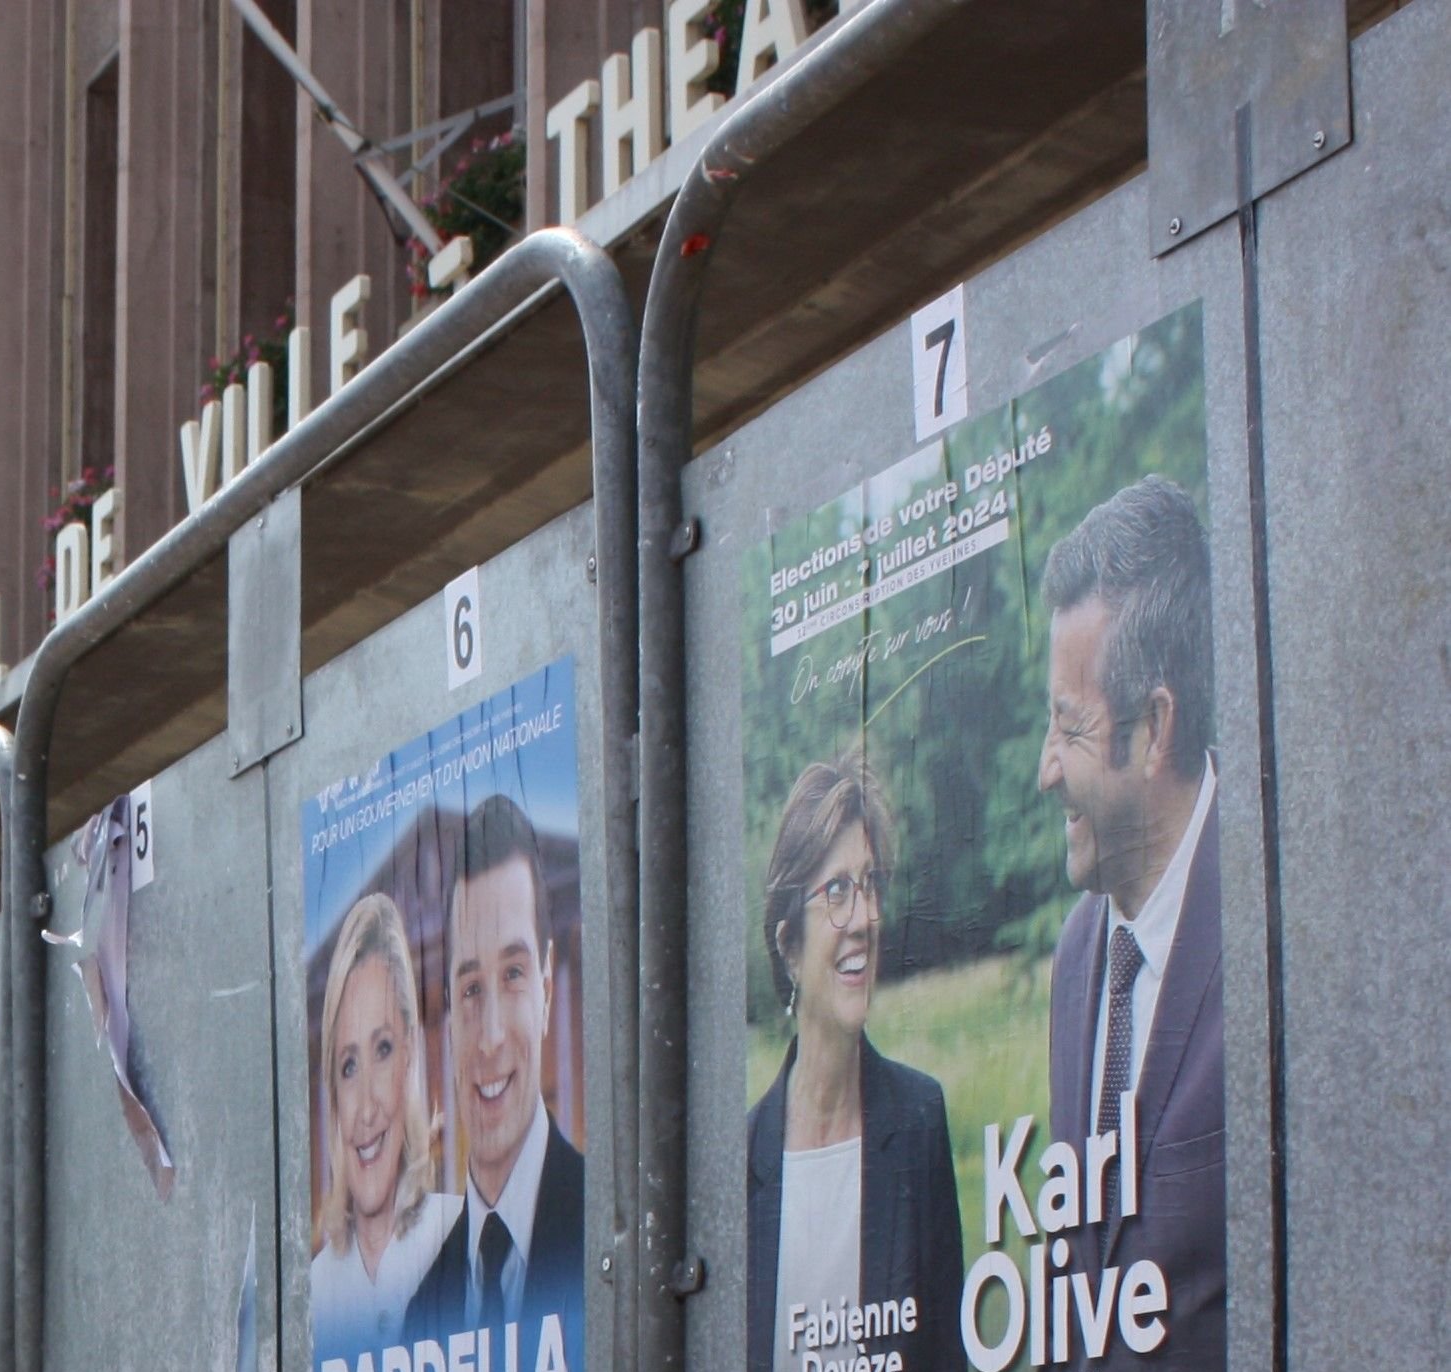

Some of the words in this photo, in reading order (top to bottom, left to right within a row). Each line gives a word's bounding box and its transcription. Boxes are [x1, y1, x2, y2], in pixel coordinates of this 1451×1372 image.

[56, 487, 123, 625] DE
[547, 0, 866, 225] THEA
[925, 318, 956, 417] 7
[771, 535, 862, 597] Elections
[863, 517, 892, 545] de
[899, 482, 958, 525] votre
[965, 426, 1051, 493] Député
[771, 600, 797, 632] 30
[803, 583, 838, 621] juin
[876, 526, 937, 581] juillet
[942, 490, 1008, 545] 2024
[454, 596, 474, 670] 6
[791, 655, 819, 704] On
[883, 629, 909, 661] sur
[916, 609, 952, 644] vous
[960, 586, 971, 624] !
[820, 577, 903, 627] CIRCONSRIPTION
[136, 801, 148, 860] 5
[310, 823, 338, 855] POUR
[339, 813, 354, 841] UN
[355, 771, 440, 832] GOUVERNEMENT
[493, 703, 563, 757] NATIONALE
[985, 1090, 1138, 1243] Karl
[789, 1296, 918, 1351] Fabienne
